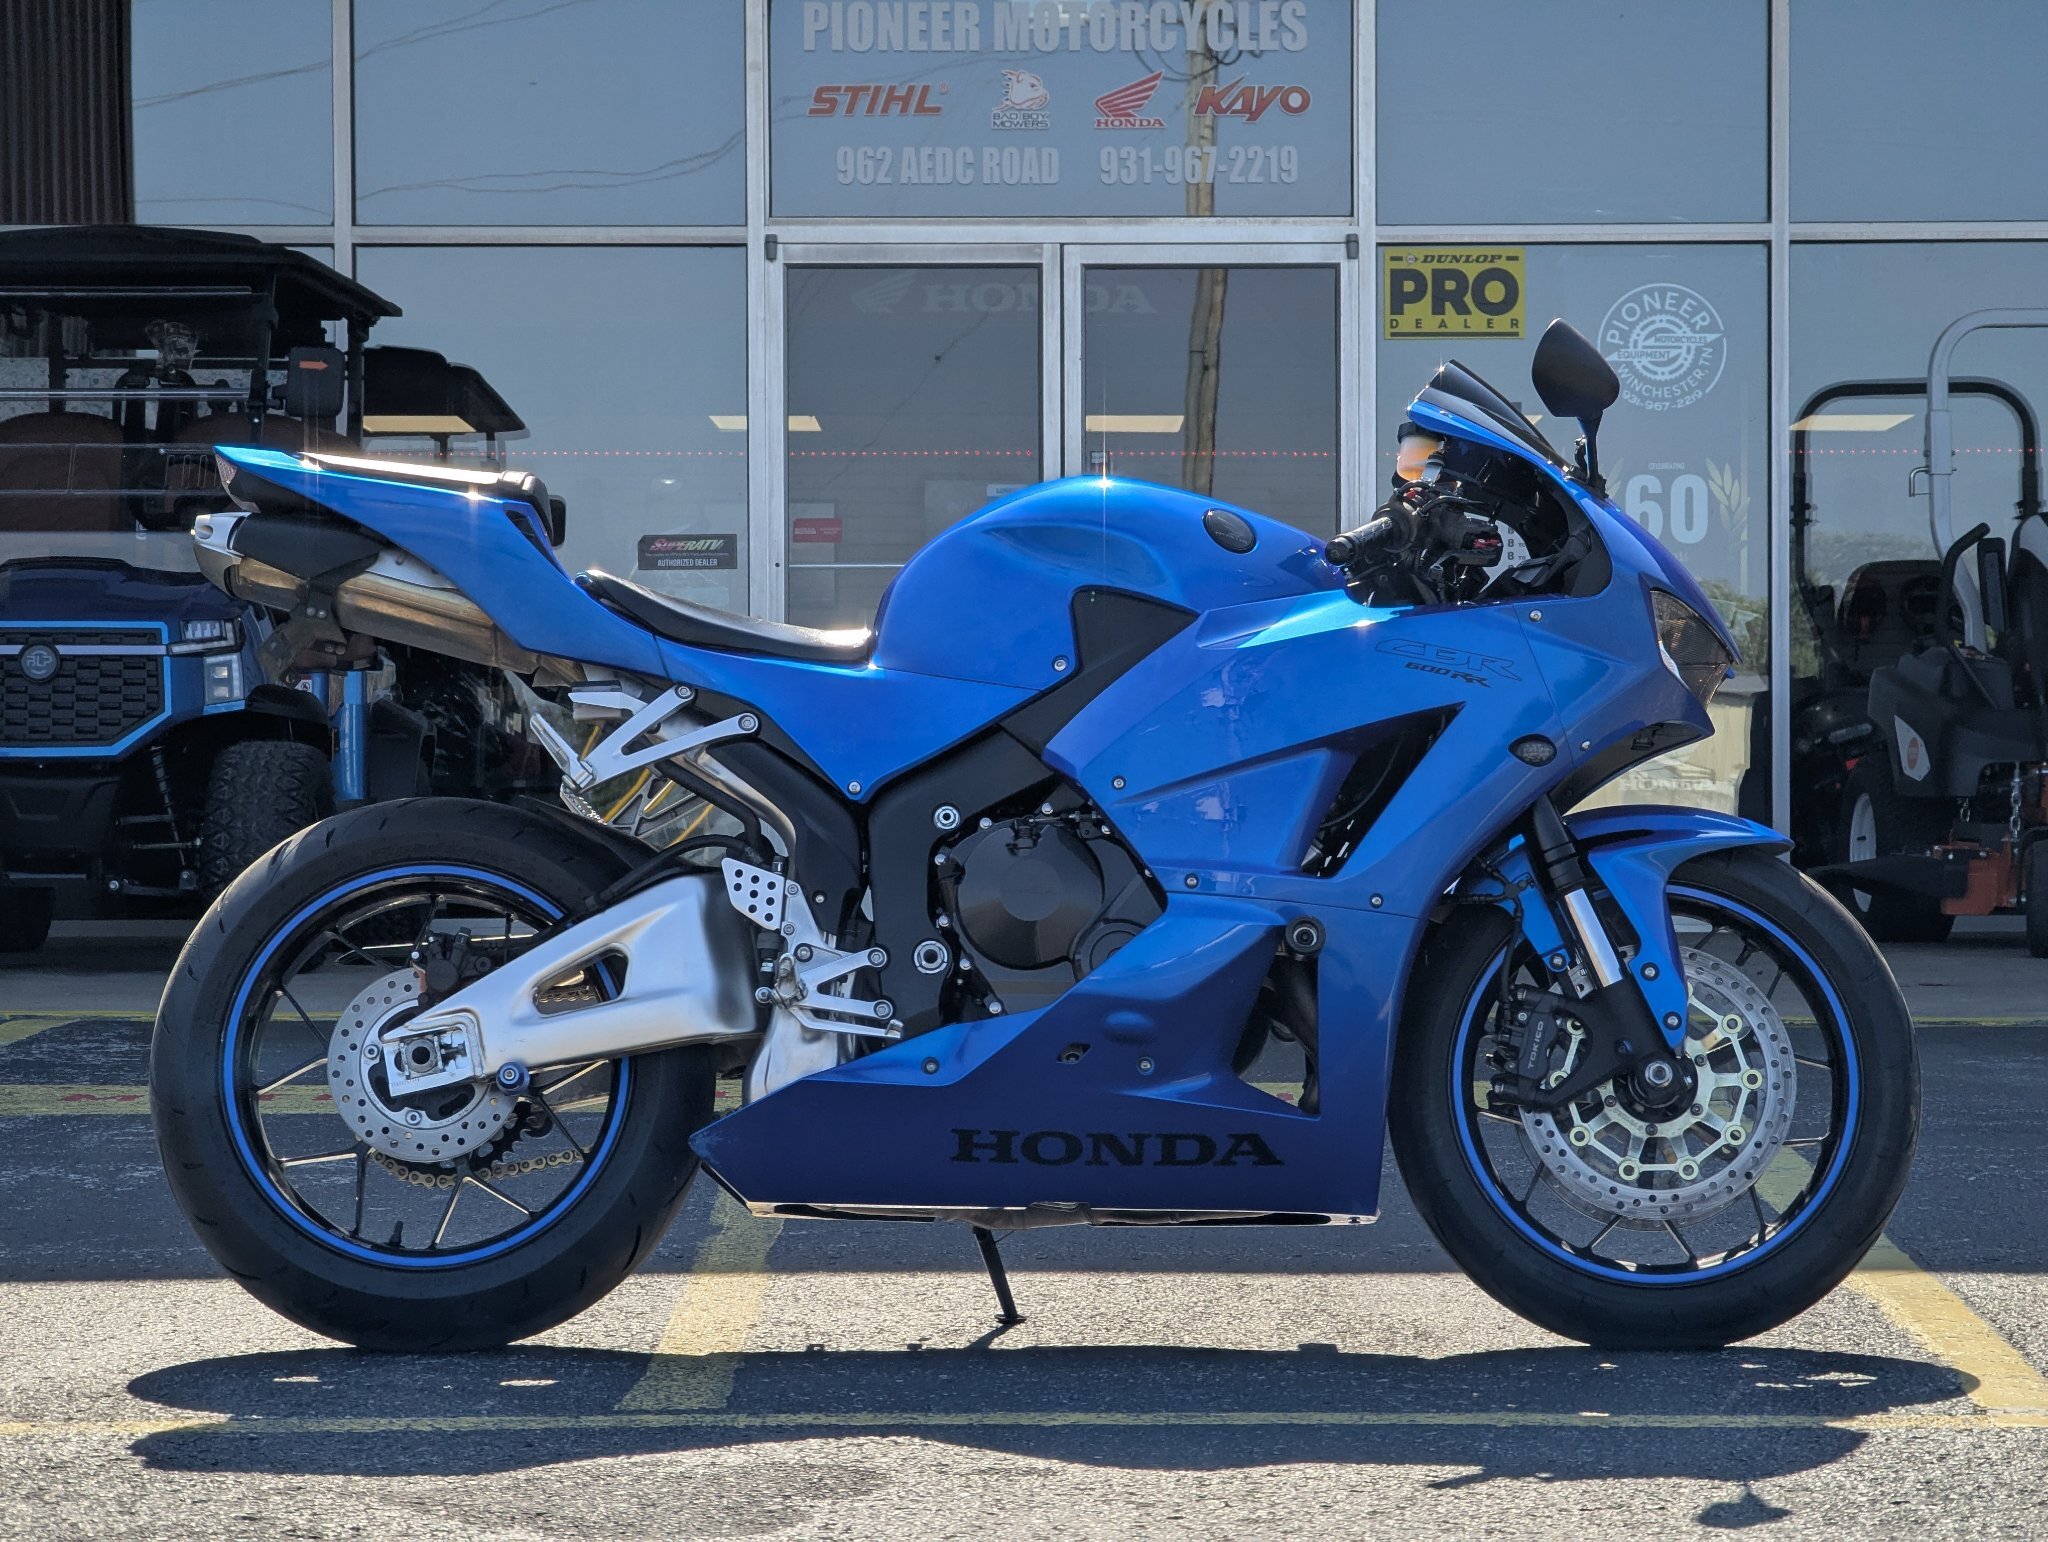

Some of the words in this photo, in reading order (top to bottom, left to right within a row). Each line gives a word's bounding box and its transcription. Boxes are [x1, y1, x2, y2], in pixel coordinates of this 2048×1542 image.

[803, 1, 981, 52] PIONEER
[994, 1, 1308, 52] MOTORCYCLES
[807, 84, 942, 116] STIHL
[1195, 76, 1311, 122] KAYO
[992, 112, 1019, 120] BAD
[1022, 112, 1046, 120] BOY
[1096, 118, 1165, 128] HONDA
[836, 145, 892, 185] 962
[900, 145, 974, 185] AEDC
[982, 145, 1060, 185] ROAD
[1100, 145, 1298, 185] 931-967-2219
[1421, 254, 1502, 264] DUNLOP
[1390, 267, 1519, 316] PRO
[1390, 319, 1519, 329] DEALER
[1606, 291, 1711, 346] PIONEER
[1617, 350, 1671, 360] EQUIPMENT
[1654, 335, 1708, 344] MOTORCYCLES
[1622, 389, 1703, 412] 931-967-2219
[1625, 474, 1709, 544] 60
[1507, 538, 1515, 548] 8
[1507, 551, 1515, 560] 8
[657, 559, 694, 567] AUTHORIZED
[695, 558, 718, 566] DEALER
[1375, 638, 1523, 683] CBR
[1527, 1020, 1544, 1069] TOKICO
[950, 1128, 1285, 1167] HONDA
